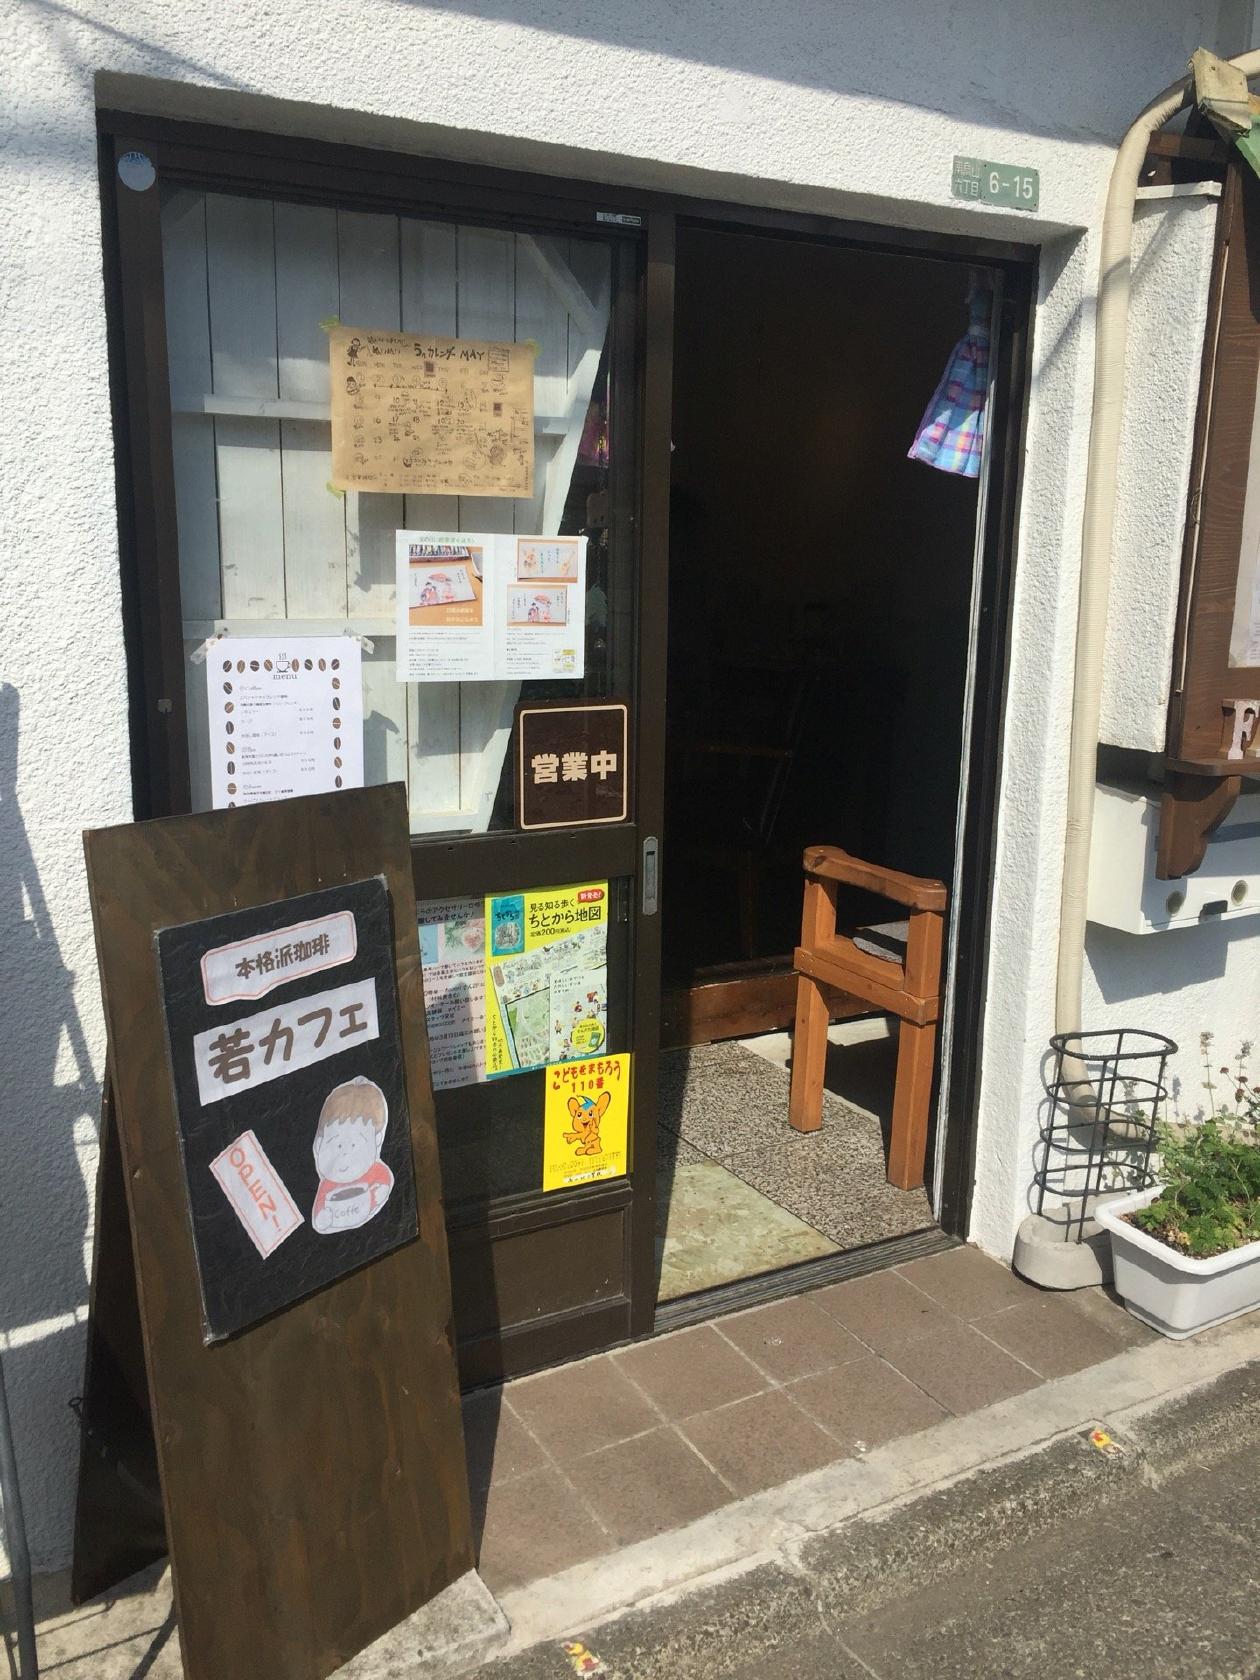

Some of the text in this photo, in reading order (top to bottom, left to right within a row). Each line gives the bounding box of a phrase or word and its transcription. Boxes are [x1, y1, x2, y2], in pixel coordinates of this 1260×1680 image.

[989, 171, 1033, 199] 6-15
[460, 349, 486, 361] MAY
[531, 750, 617, 784] 営業中
[529, 906, 601, 928] ちとから地図
[530, 898, 575, 913] 見る知る歩く
[235, 933, 330, 979] 本格派珈琲
[208, 1002, 368, 1084] 若カフェ
[553, 1061, 621, 1091] こどもをまもろう
[571, 1077, 604, 1093] 110番
